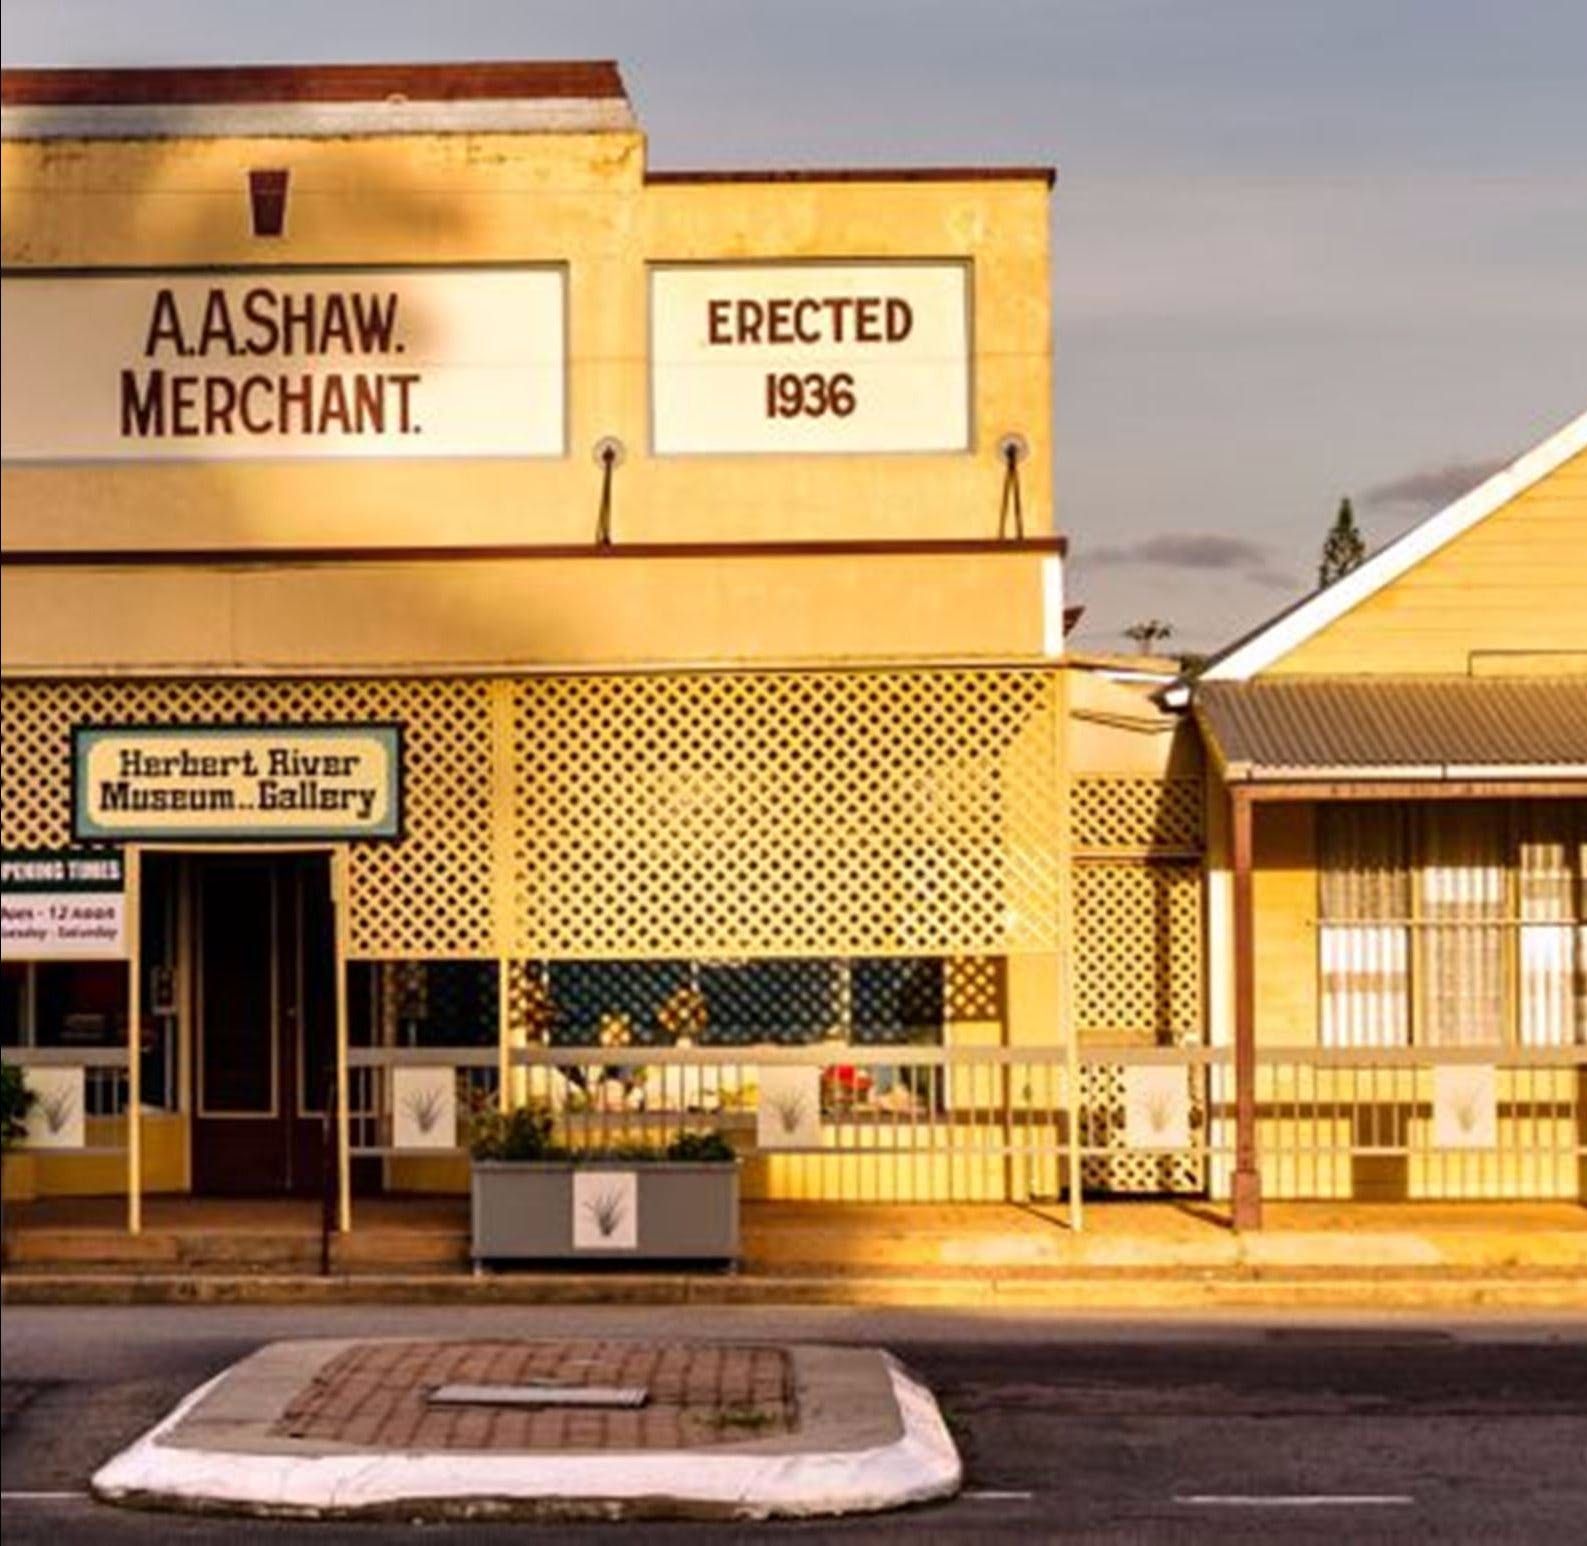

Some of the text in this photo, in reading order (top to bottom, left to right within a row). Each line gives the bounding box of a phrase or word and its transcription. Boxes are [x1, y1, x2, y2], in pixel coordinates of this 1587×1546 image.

[707, 297, 915, 345] ERECTED
[765, 372, 857, 419] 1936
[119, 749, 360, 776] Herbert River
